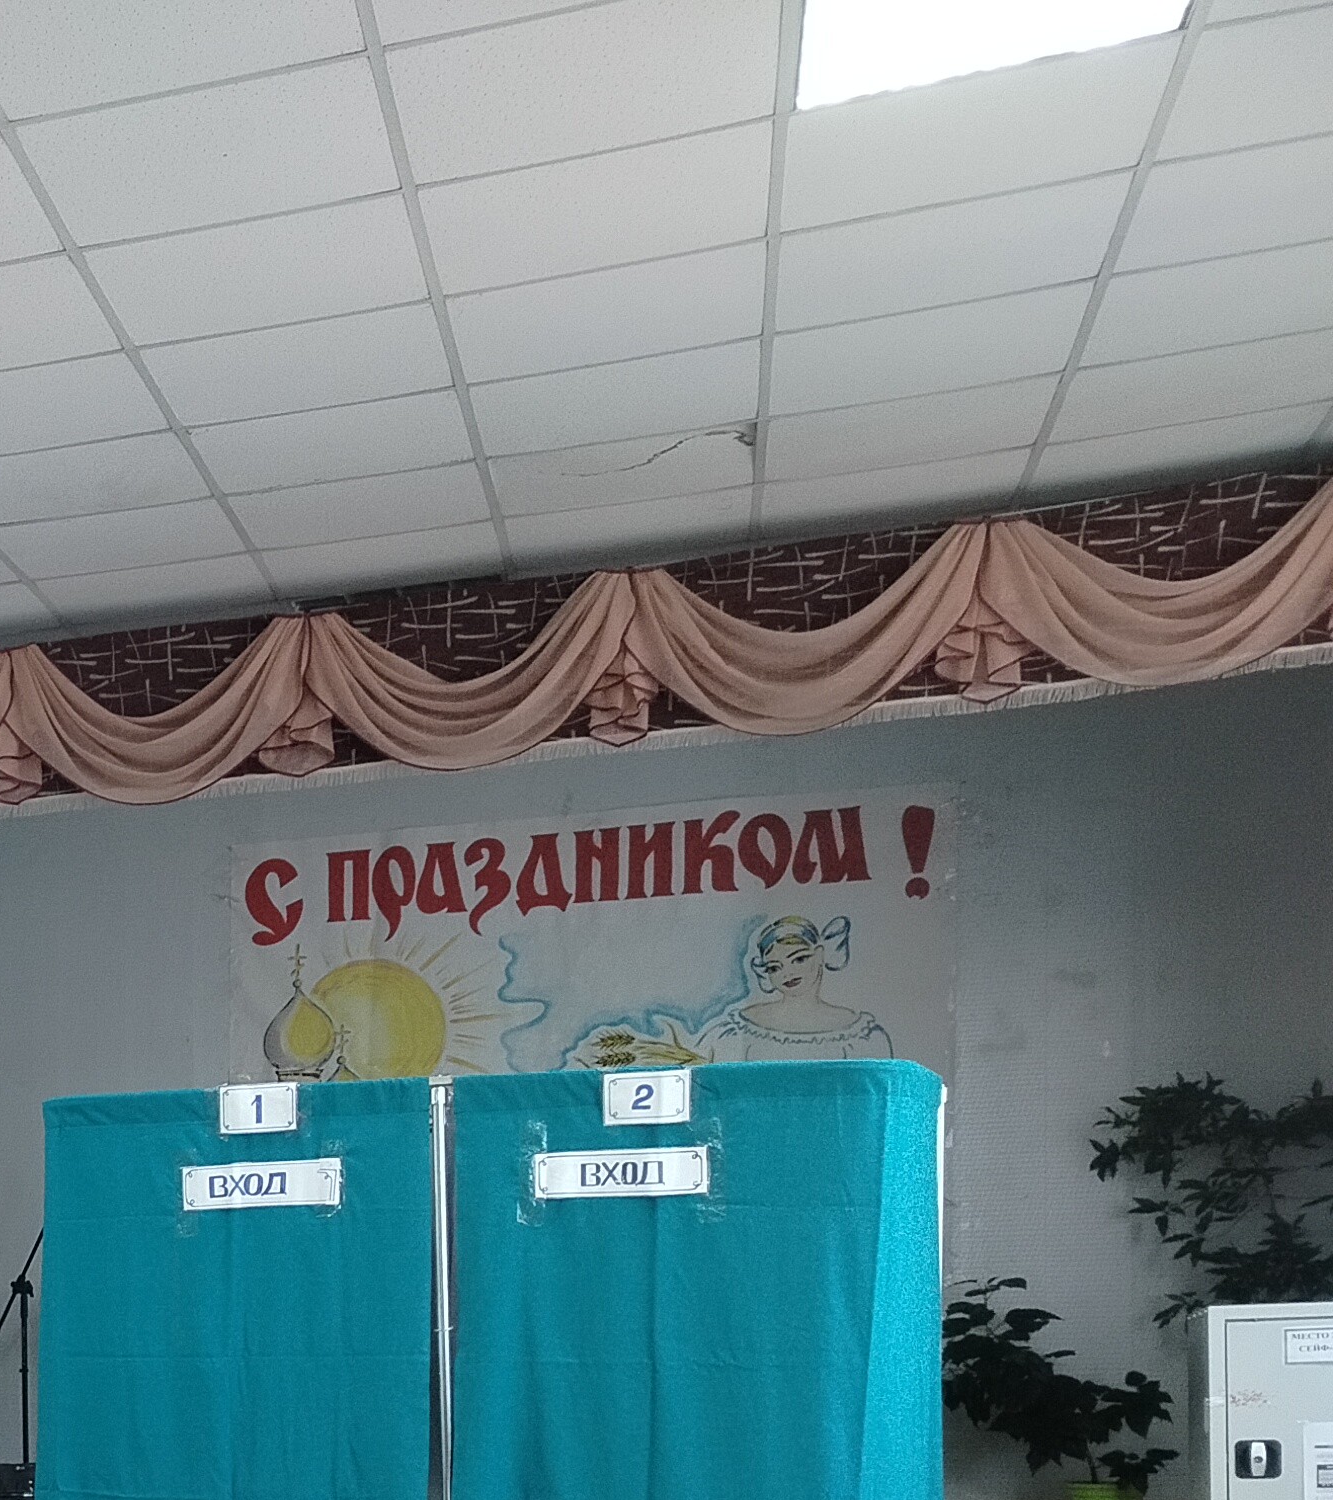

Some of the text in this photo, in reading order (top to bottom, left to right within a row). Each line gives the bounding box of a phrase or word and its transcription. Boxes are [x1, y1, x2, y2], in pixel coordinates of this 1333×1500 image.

[245, 857, 303, 946] С
[326, 805, 873, 943] ПРАЗДНИКОМ
[251, 1094, 263, 1124] 1
[631, 1084, 654, 1110] 2
[208, 1171, 287, 1199] ВХОД
[580, 1160, 666, 1187] ВХОД
[1292, 1332, 1329, 1340] МЕСТО
